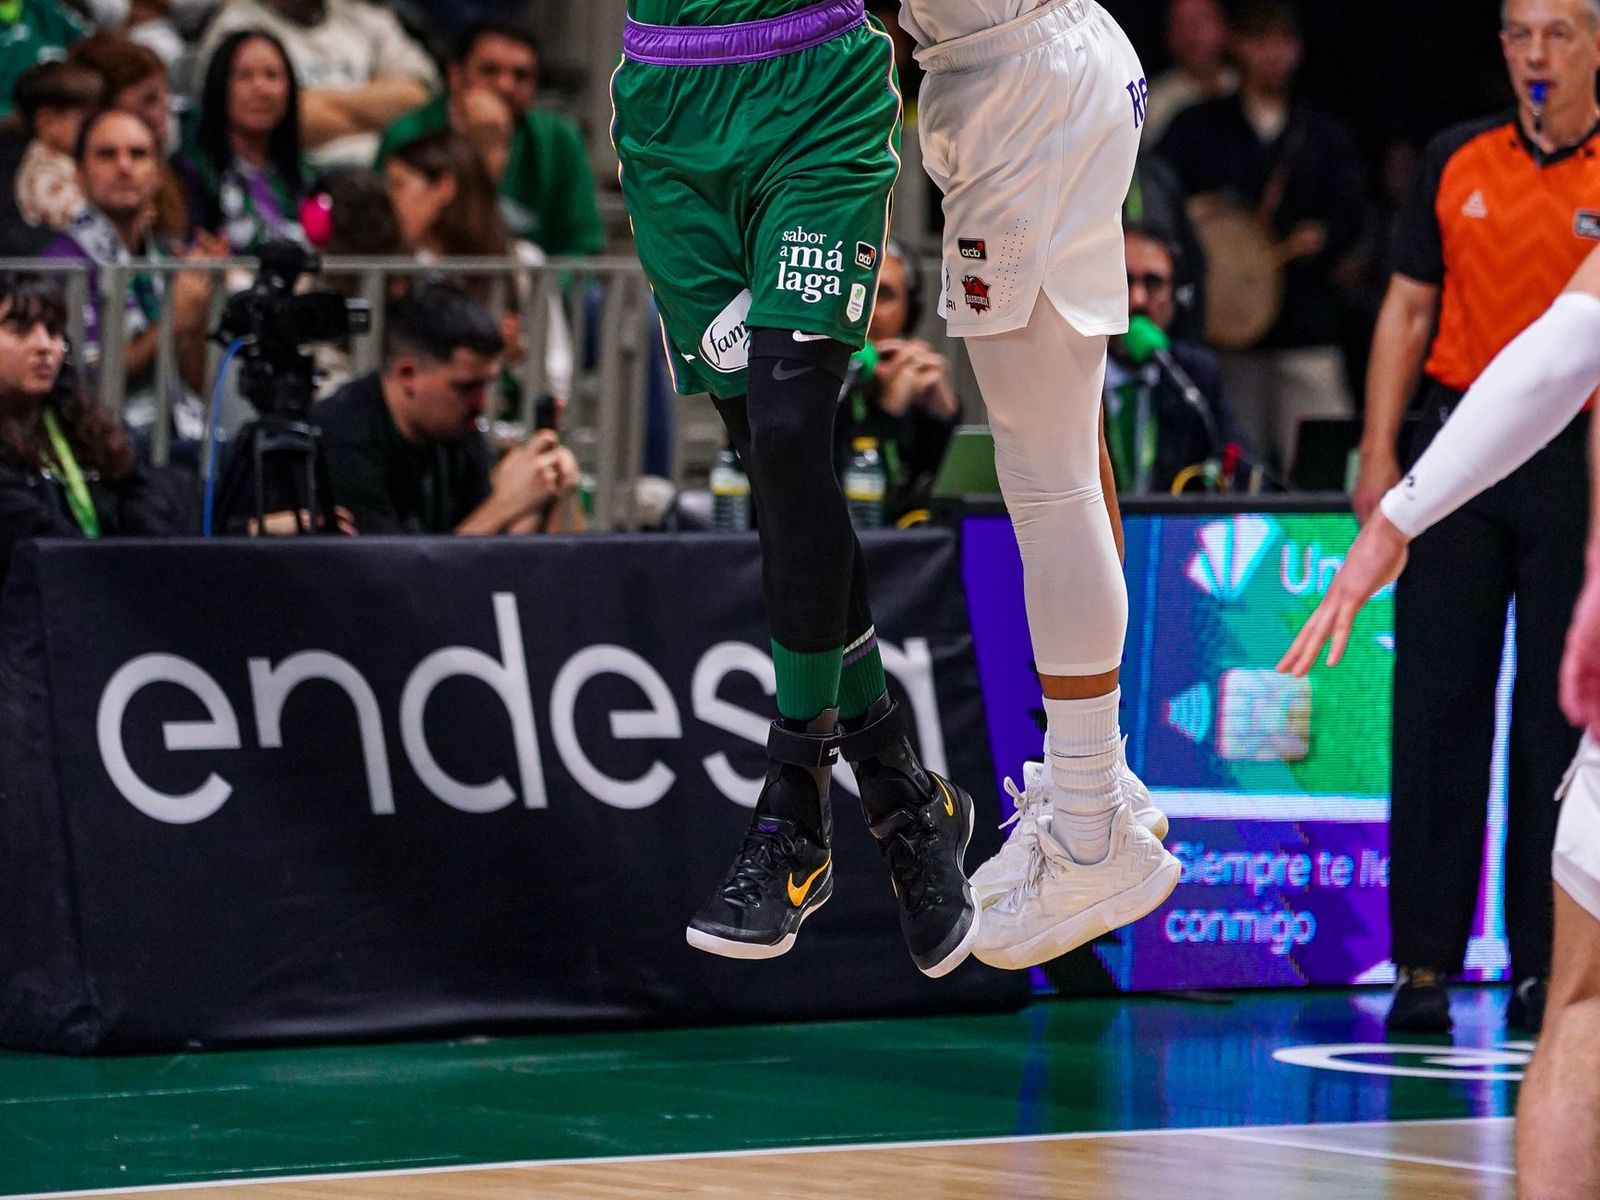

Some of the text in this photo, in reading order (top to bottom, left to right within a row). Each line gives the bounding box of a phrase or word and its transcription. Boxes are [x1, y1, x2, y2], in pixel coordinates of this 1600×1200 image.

[781, 225, 828, 245] sabor
[961, 247, 981, 258] acb
[776, 261, 842, 303] laga
[1317, 849, 1354, 888] te
[1163, 901, 1317, 955] conmigo
